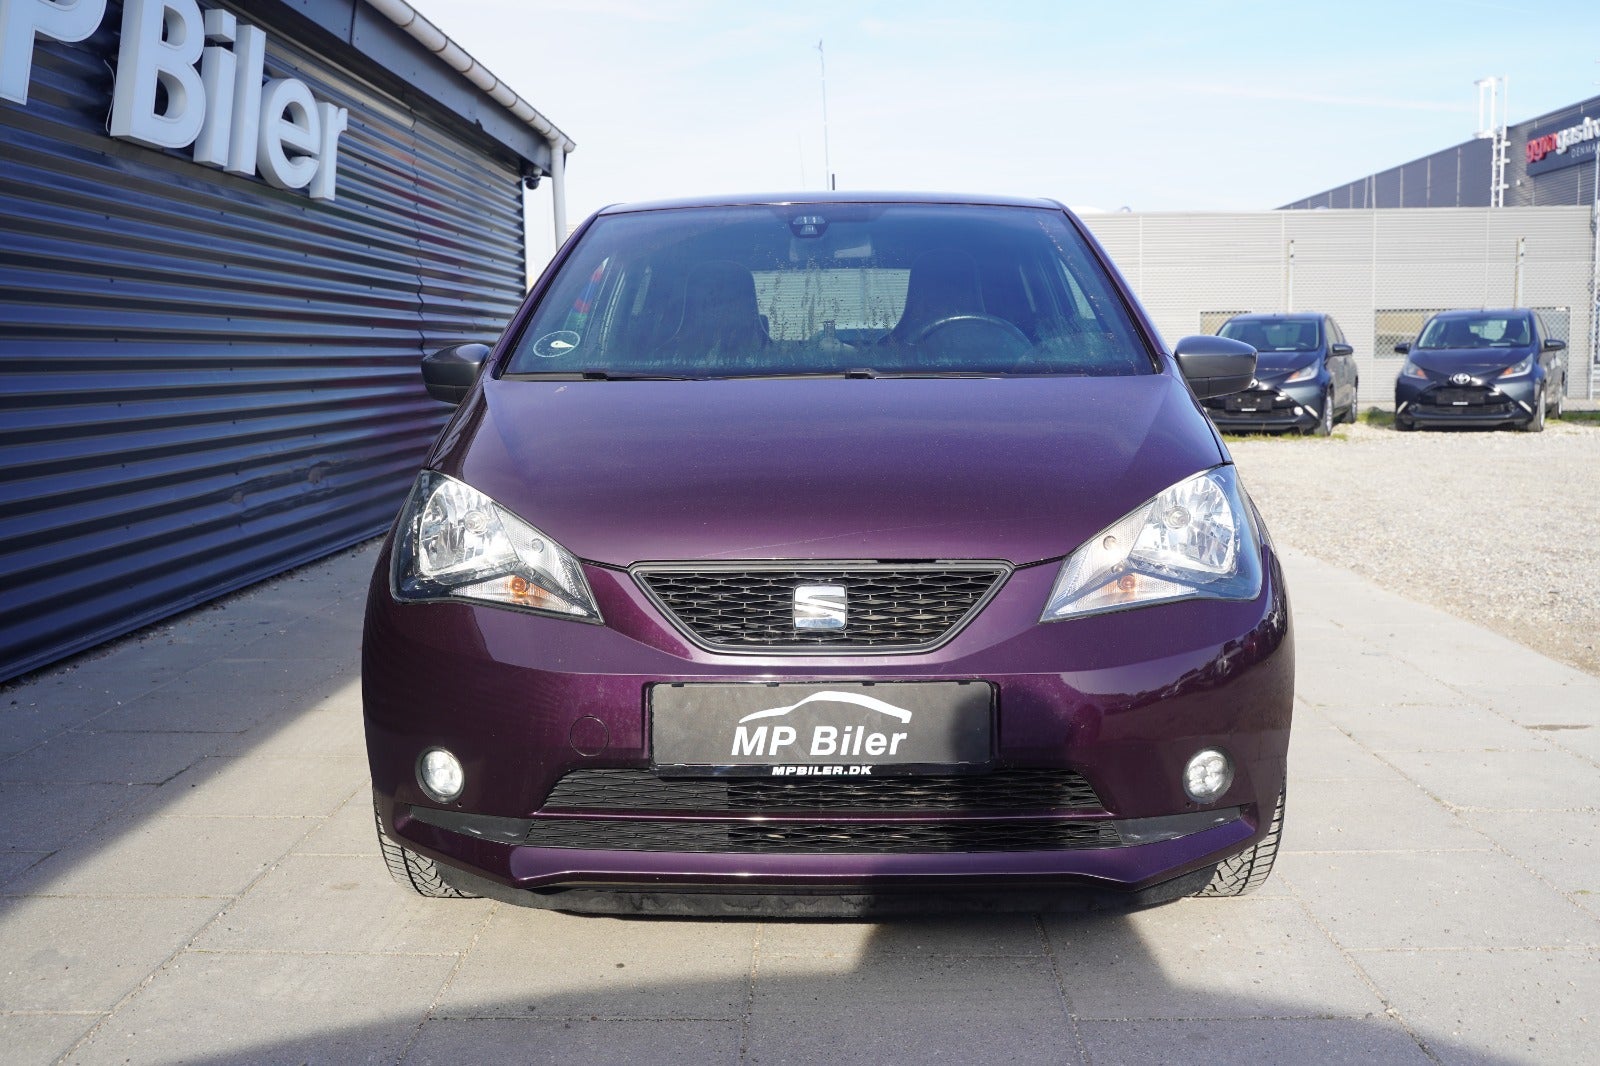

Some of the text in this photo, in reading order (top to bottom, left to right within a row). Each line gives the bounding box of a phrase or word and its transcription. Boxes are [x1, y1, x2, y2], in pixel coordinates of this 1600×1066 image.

[110, 0, 348, 200] Biler
[1571, 141, 1600, 158] DENMA
[731, 725, 907, 756] MP Biler
[771, 765, 872, 776] MPBILER.DK
